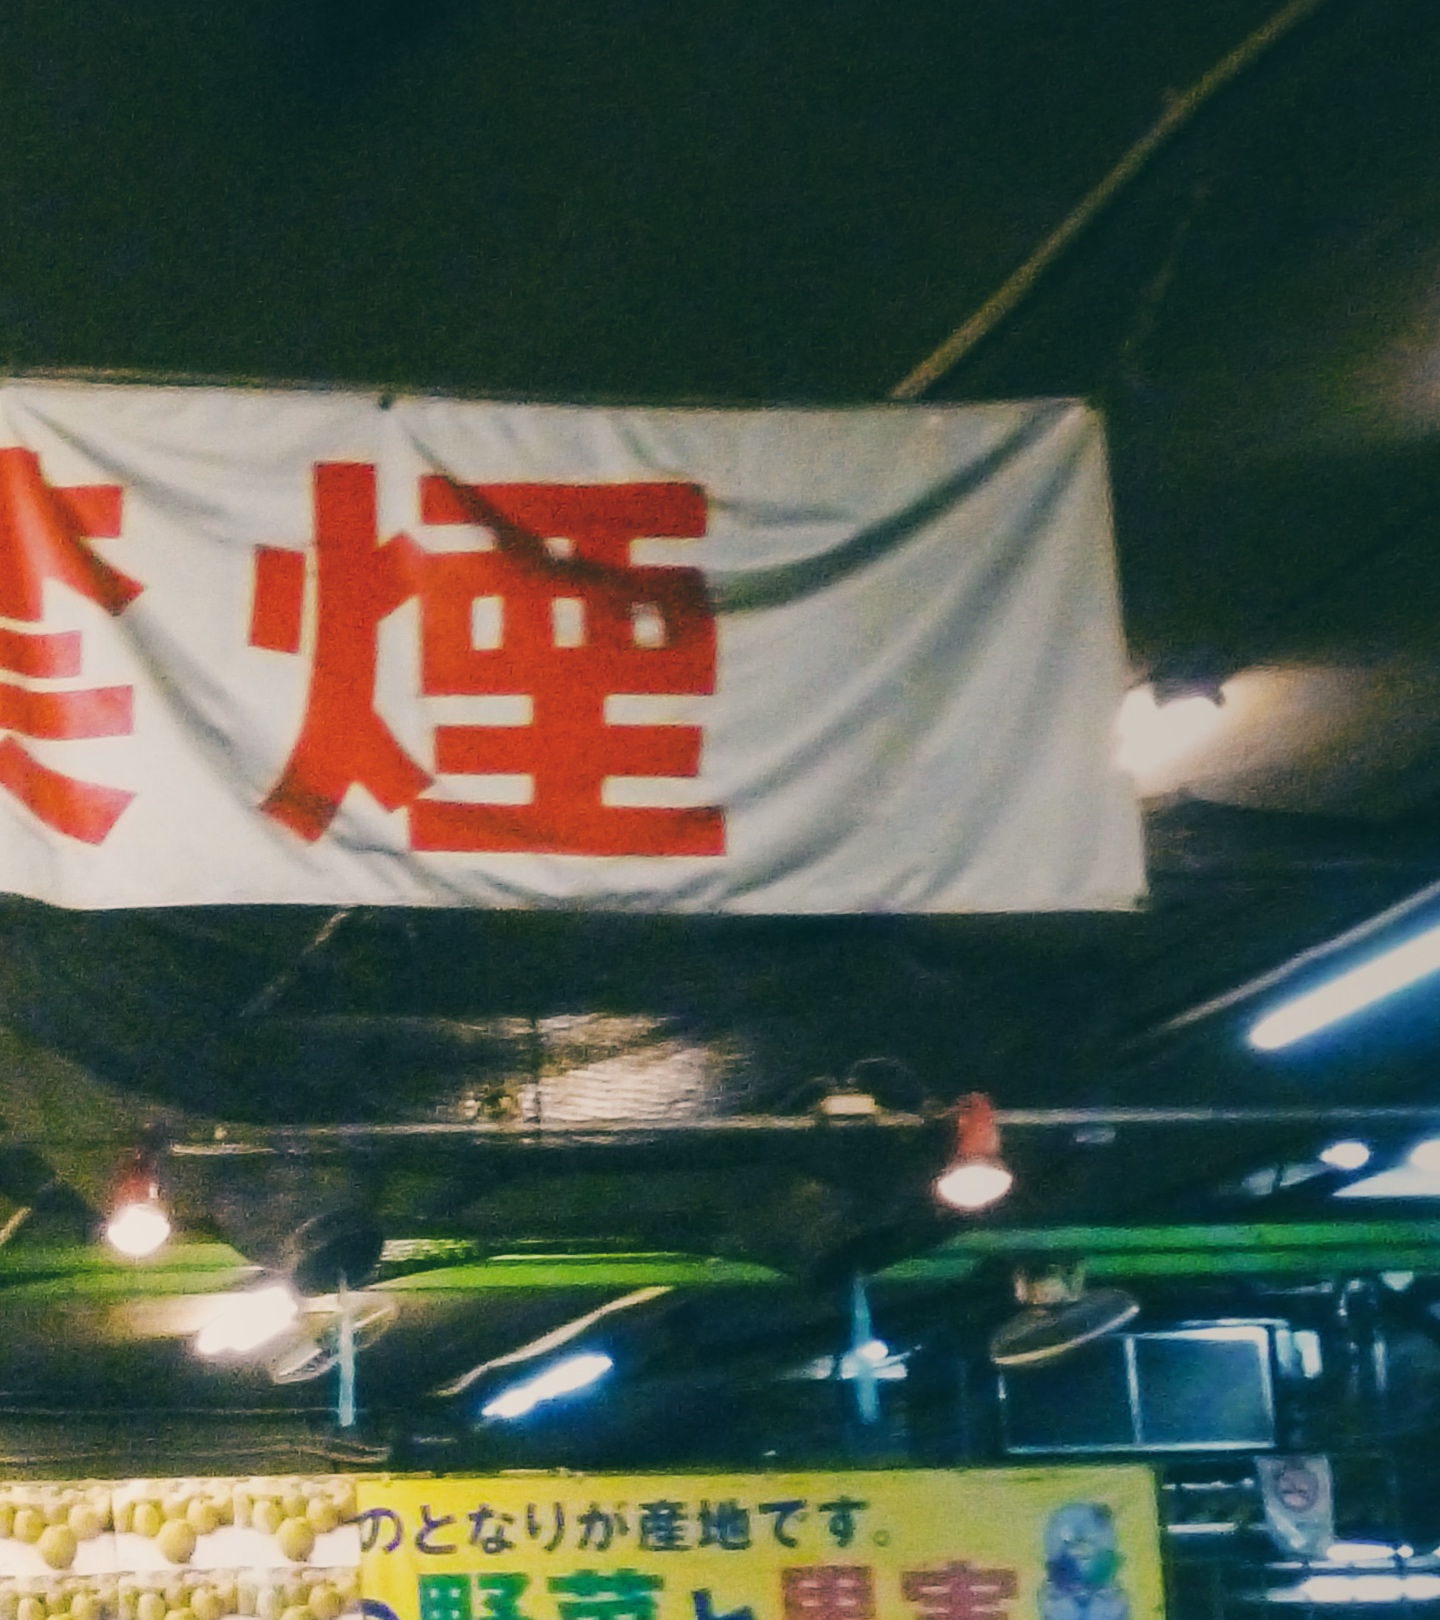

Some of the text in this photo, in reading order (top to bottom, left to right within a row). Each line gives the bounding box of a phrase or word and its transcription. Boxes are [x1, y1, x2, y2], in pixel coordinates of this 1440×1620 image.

[359, 1496, 892, 1554] のとなりが産地です。
